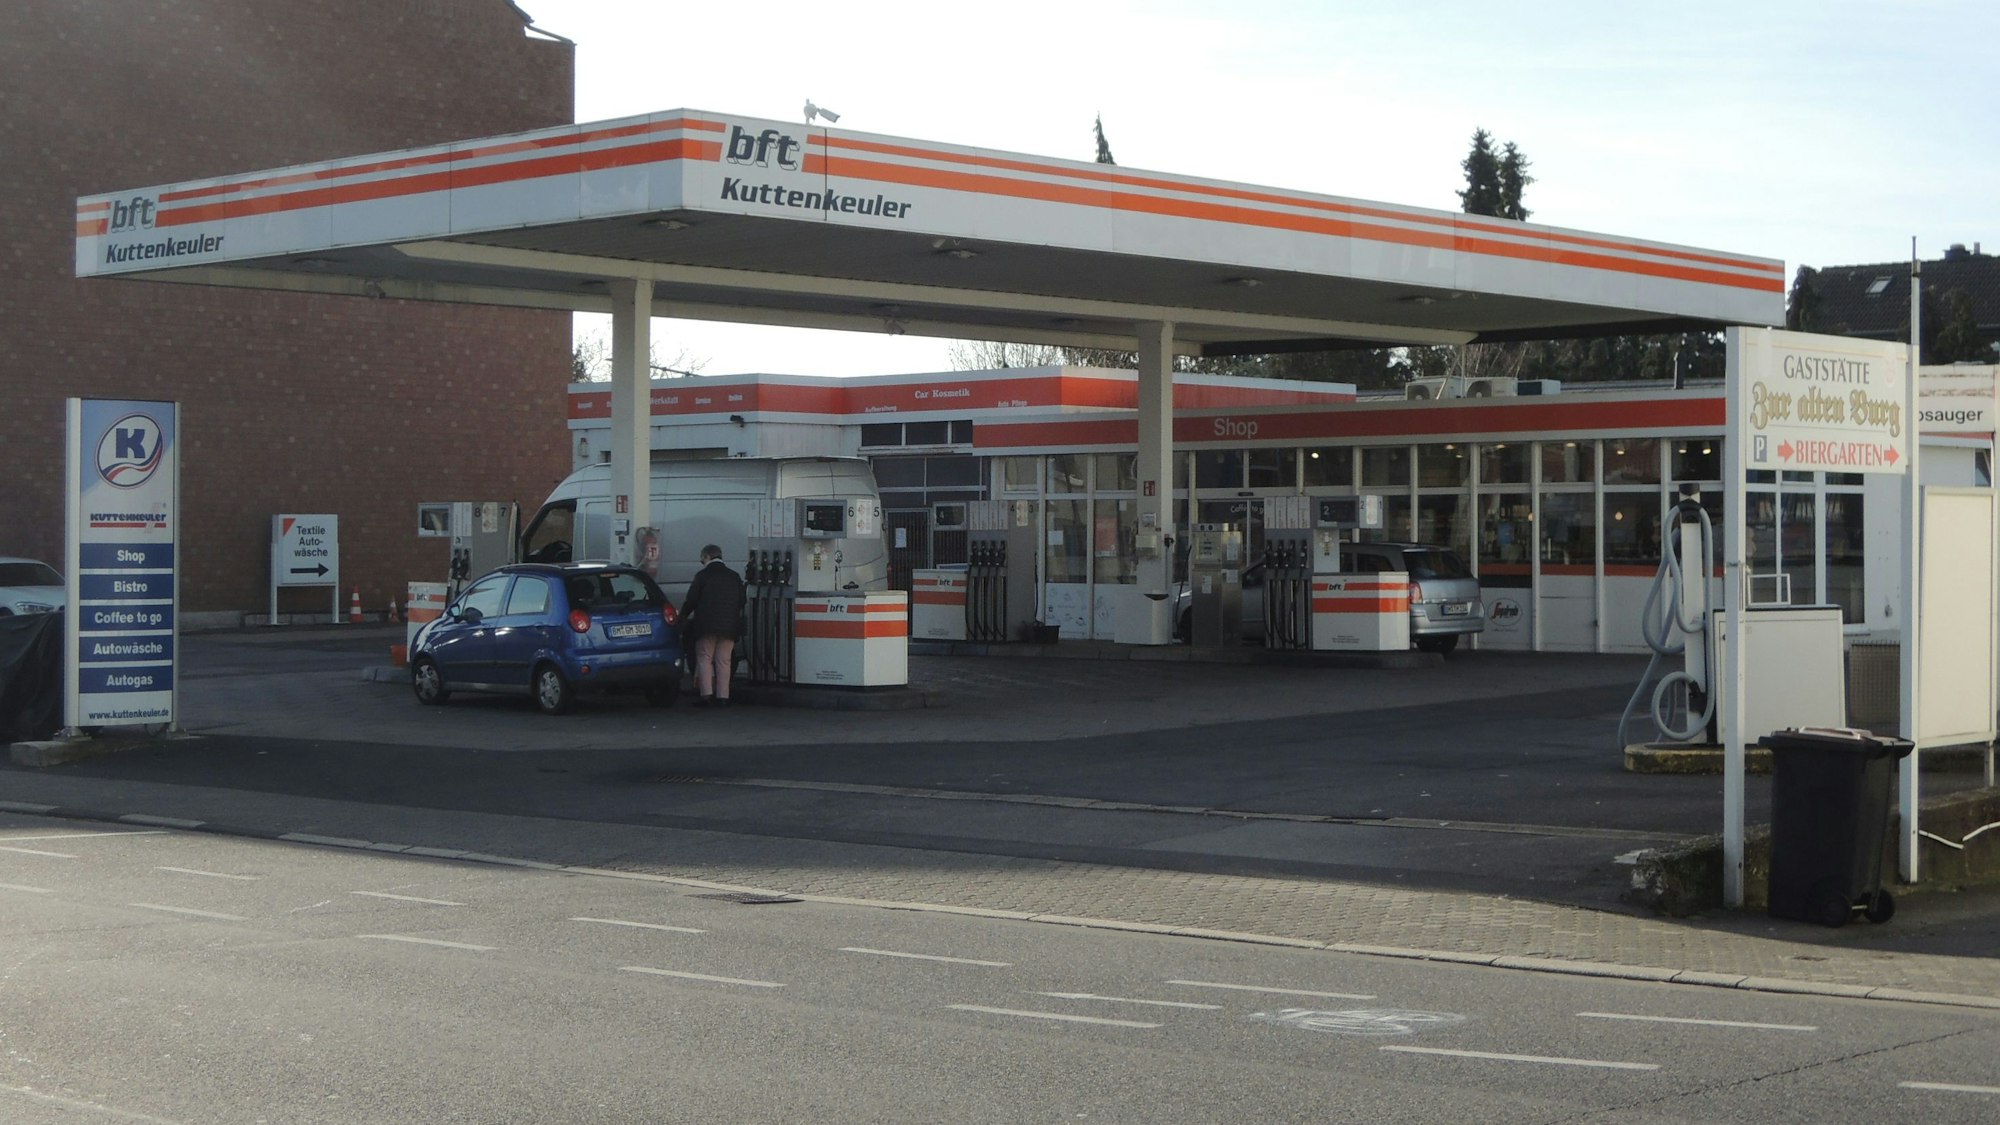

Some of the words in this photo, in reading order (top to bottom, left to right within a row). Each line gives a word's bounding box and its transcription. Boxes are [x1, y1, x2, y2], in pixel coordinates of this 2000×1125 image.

[726, 125, 800, 171] bft
[721, 177, 911, 218] Kuttenkeuler
[111, 196, 155, 233] bft
[106, 234, 224, 263] Kuttenkeuler
[1783, 354, 1870, 384] GASTSTÄTTE
[915, 390, 928, 399] Car
[933, 388, 970, 398] Kosmetik
[1750, 381, 1792, 430] Zur
[1797, 385, 1845, 424] alten
[1850, 388, 1901, 438] Burg
[1214, 418, 1258, 439] Shop
[116, 428, 146, 458] K
[1756, 437, 1765, 460] P
[1796, 440, 1883, 466] BIERGARTEN
[474, 507, 481, 518] 8
[500, 507, 507, 517] 7
[848, 506, 855, 517] 6
[873, 506, 880, 517] 5
[1323, 506, 1330, 515] 2
[296, 526, 326, 535] Textile
[299, 537, 324, 546] Auto-
[117, 550, 146, 564] Shop
[294, 548, 328, 557] wäsche
[114, 581, 148, 593] Bistro
[1328, 582, 1342, 591] bft
[830, 603, 845, 613] bft
[95, 611, 134, 624] Coffee
[137, 612, 147, 623] to
[150, 613, 162, 626] go
[93, 642, 163, 655] Autowäsche
[106, 675, 153, 688] Autogas
[88, 709, 169, 721] www.kuttenkeuler.de
